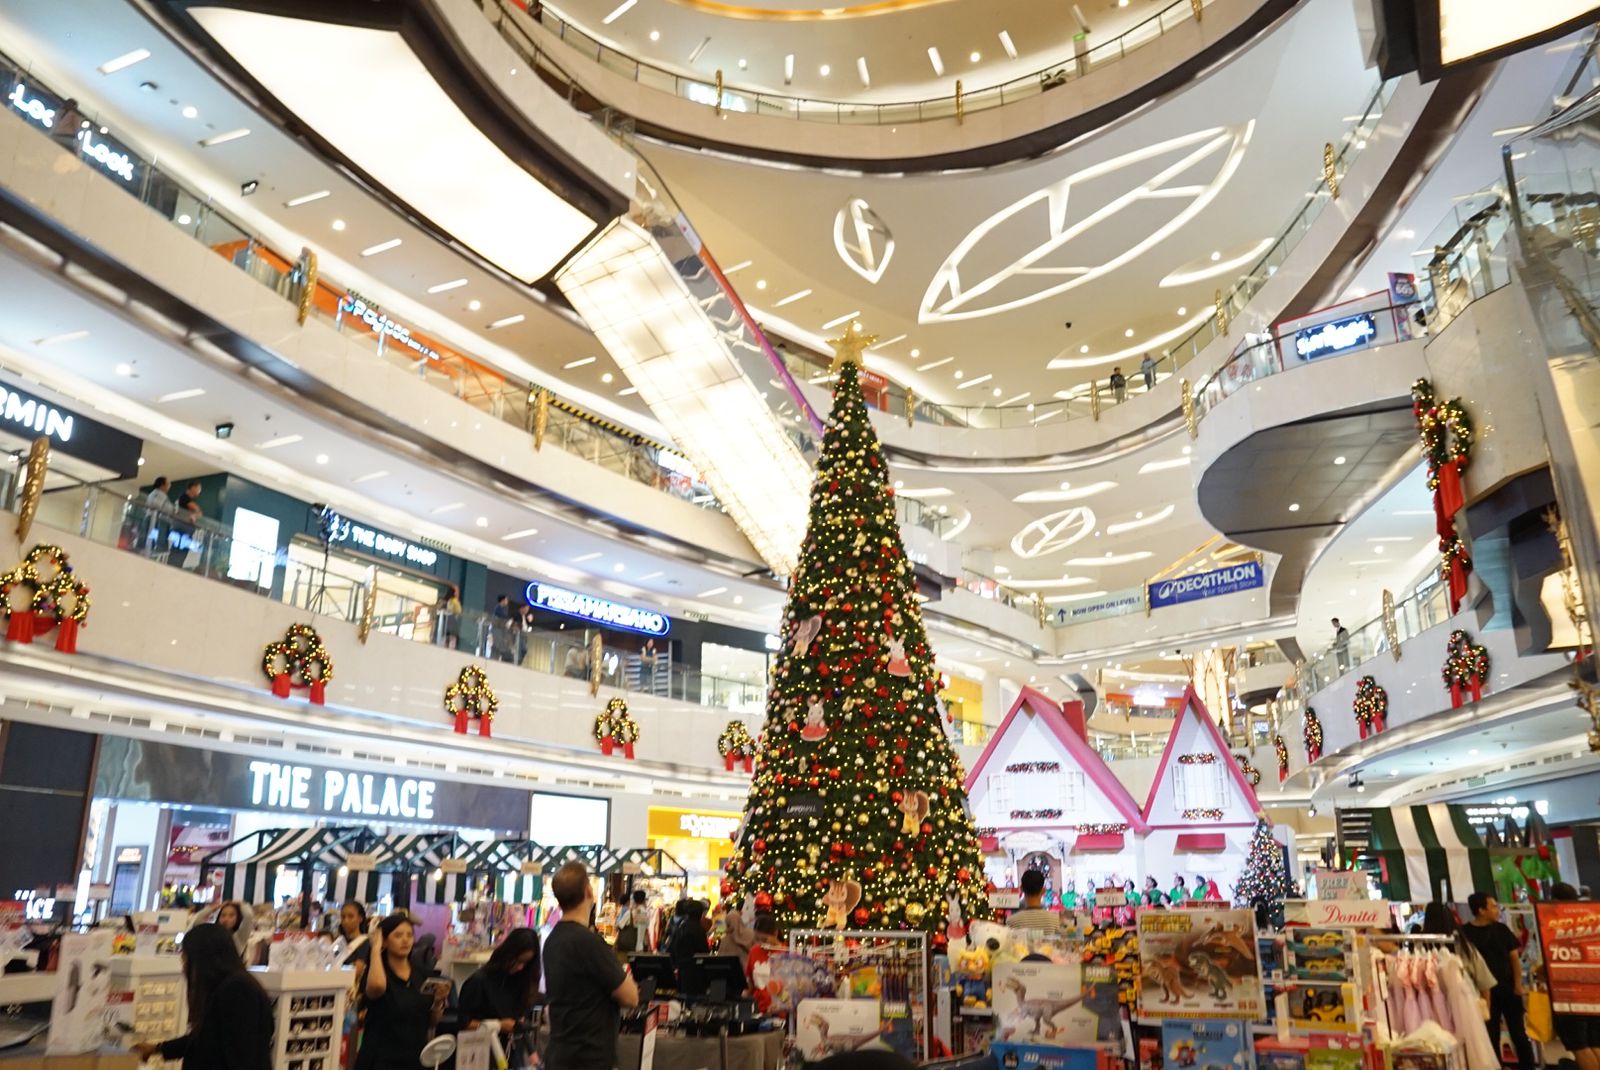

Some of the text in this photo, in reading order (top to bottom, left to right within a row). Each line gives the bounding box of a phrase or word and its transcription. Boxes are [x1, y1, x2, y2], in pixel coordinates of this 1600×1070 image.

[1177, 564, 1256, 593] DECATHLON
[1088, 604, 1105, 612] OPEN
[1116, 597, 1136, 606] LEVEL
[250, 761, 436, 819] THE PALACE
[1318, 903, 1378, 925] Donita
[1549, 945, 1582, 961] 70%
